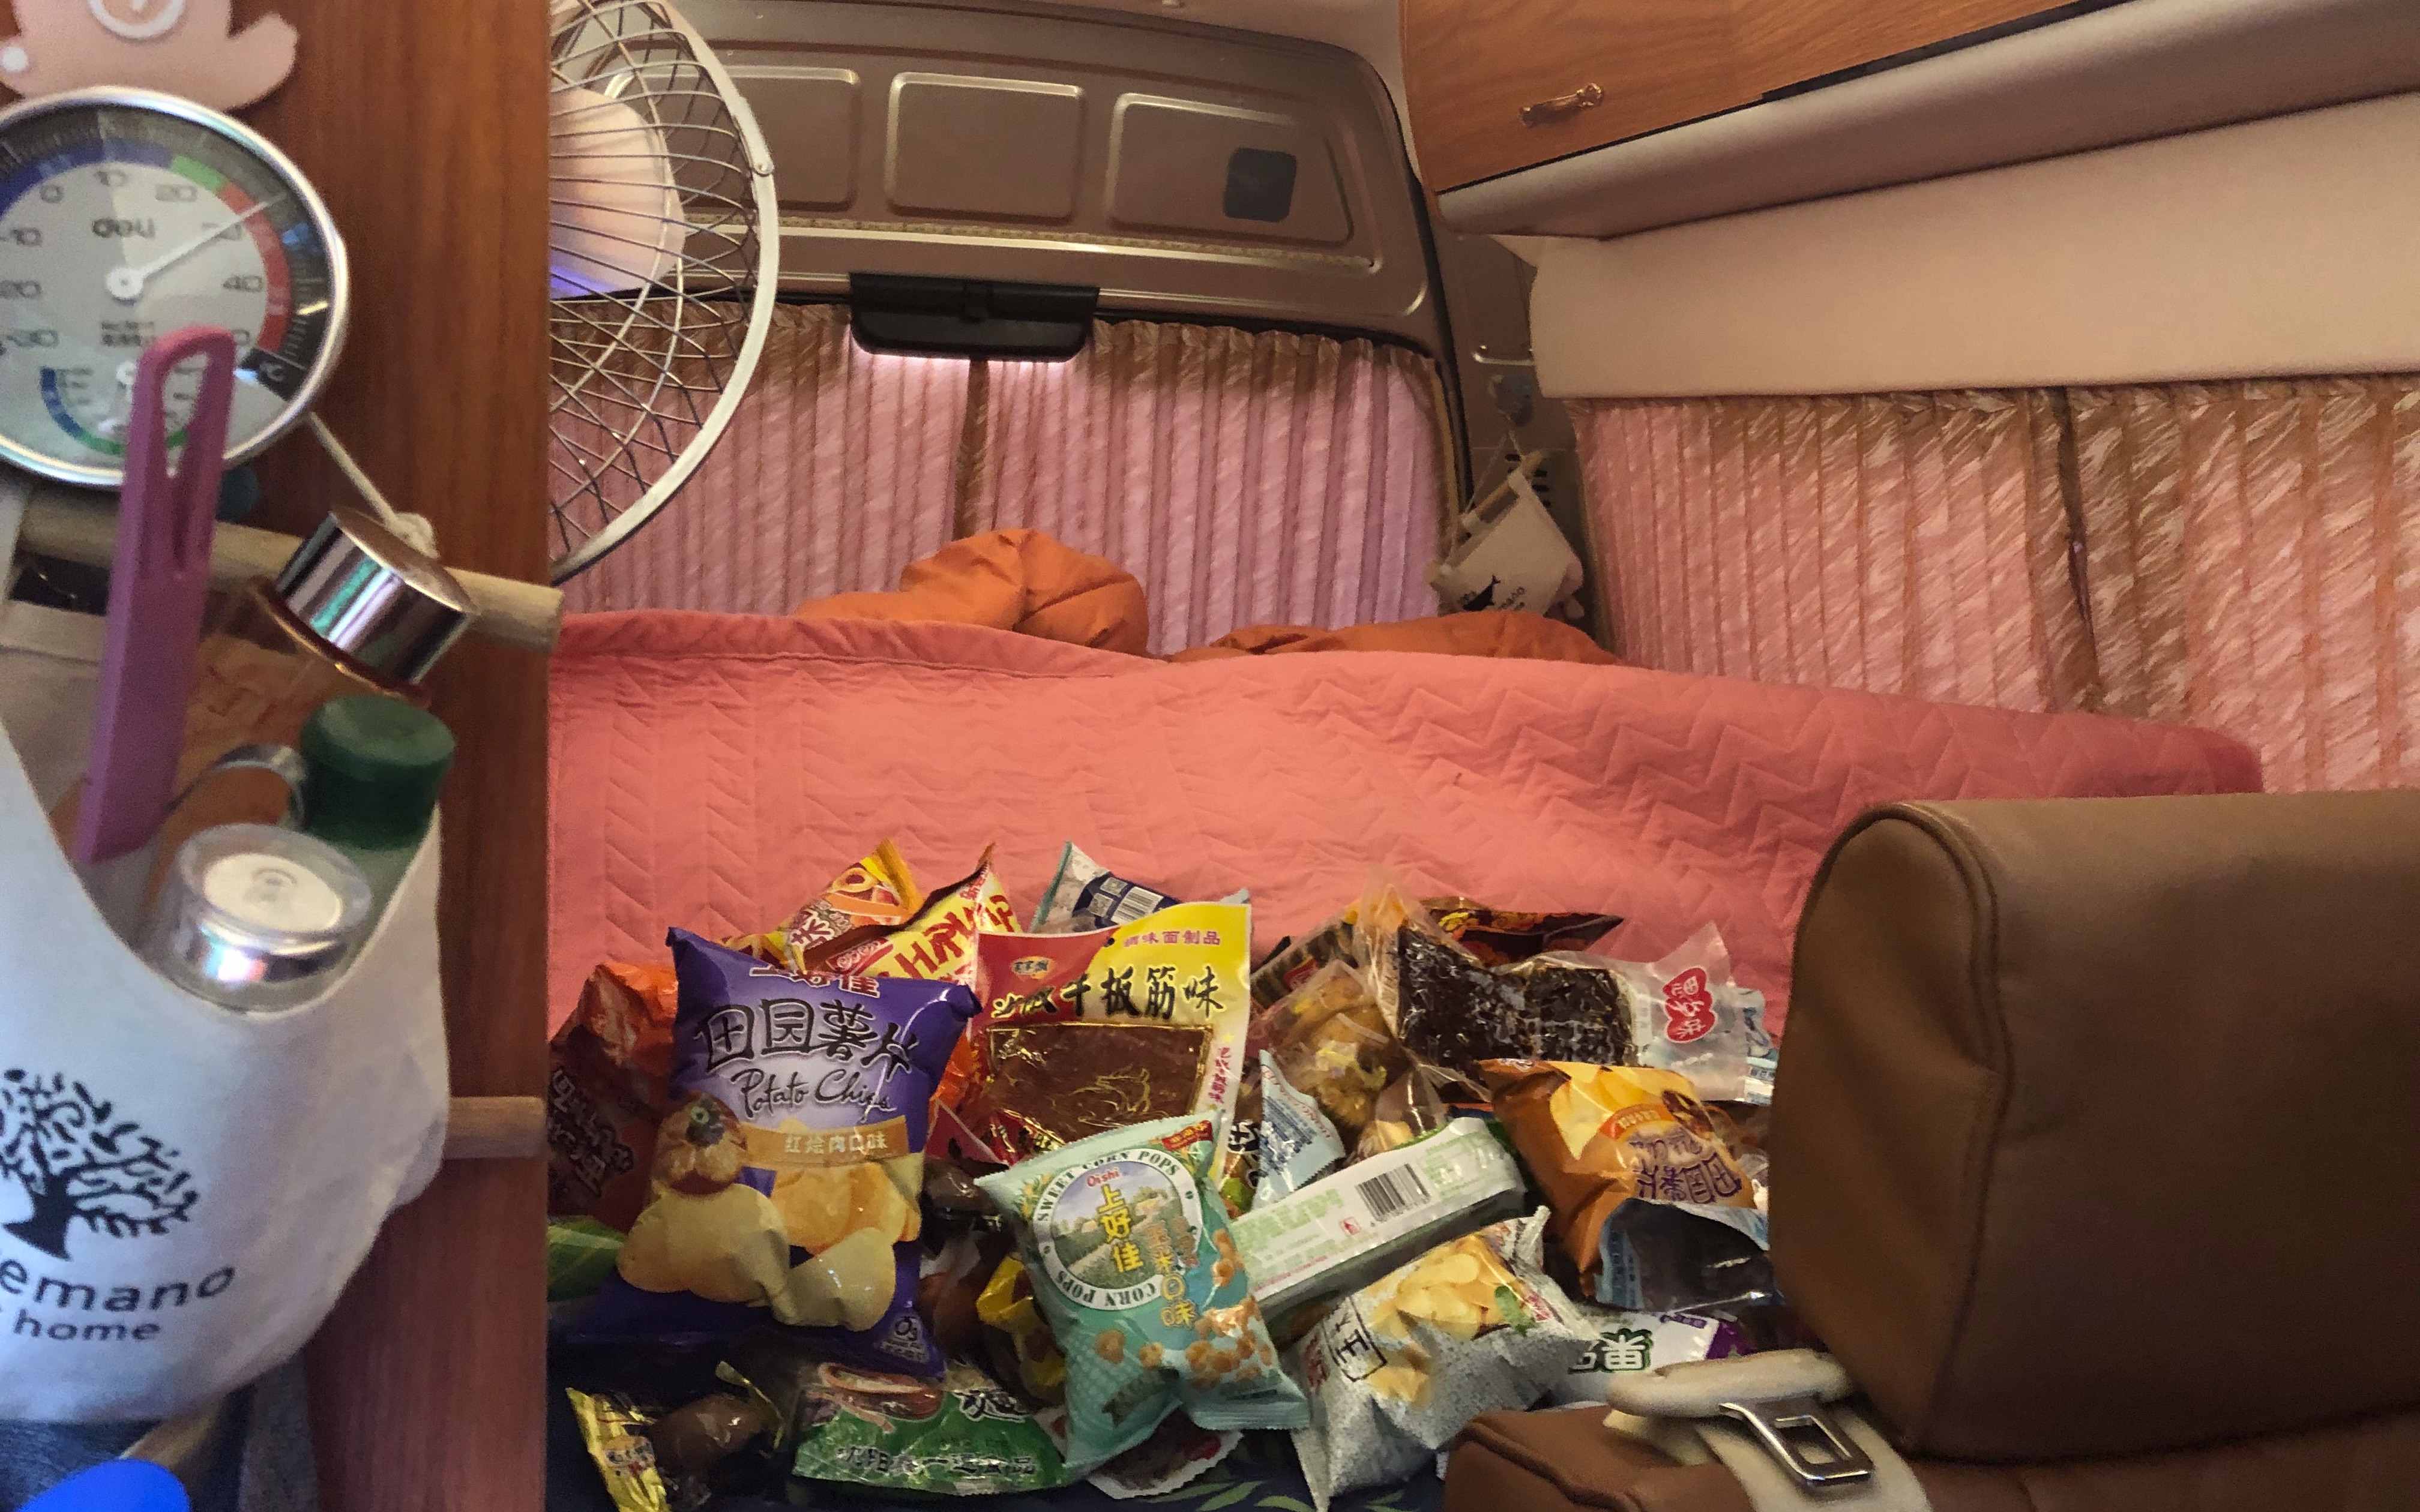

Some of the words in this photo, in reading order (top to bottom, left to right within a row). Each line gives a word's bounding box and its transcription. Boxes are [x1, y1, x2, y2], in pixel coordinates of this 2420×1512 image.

[730, 1067, 809, 1120] Potato
[1086, 1168, 1121, 1188] Oishi
[1137, 1150, 1180, 1176] POPS
[1097, 1184, 1144, 1273] 上好佳
[13, 1309, 161, 1341] home
